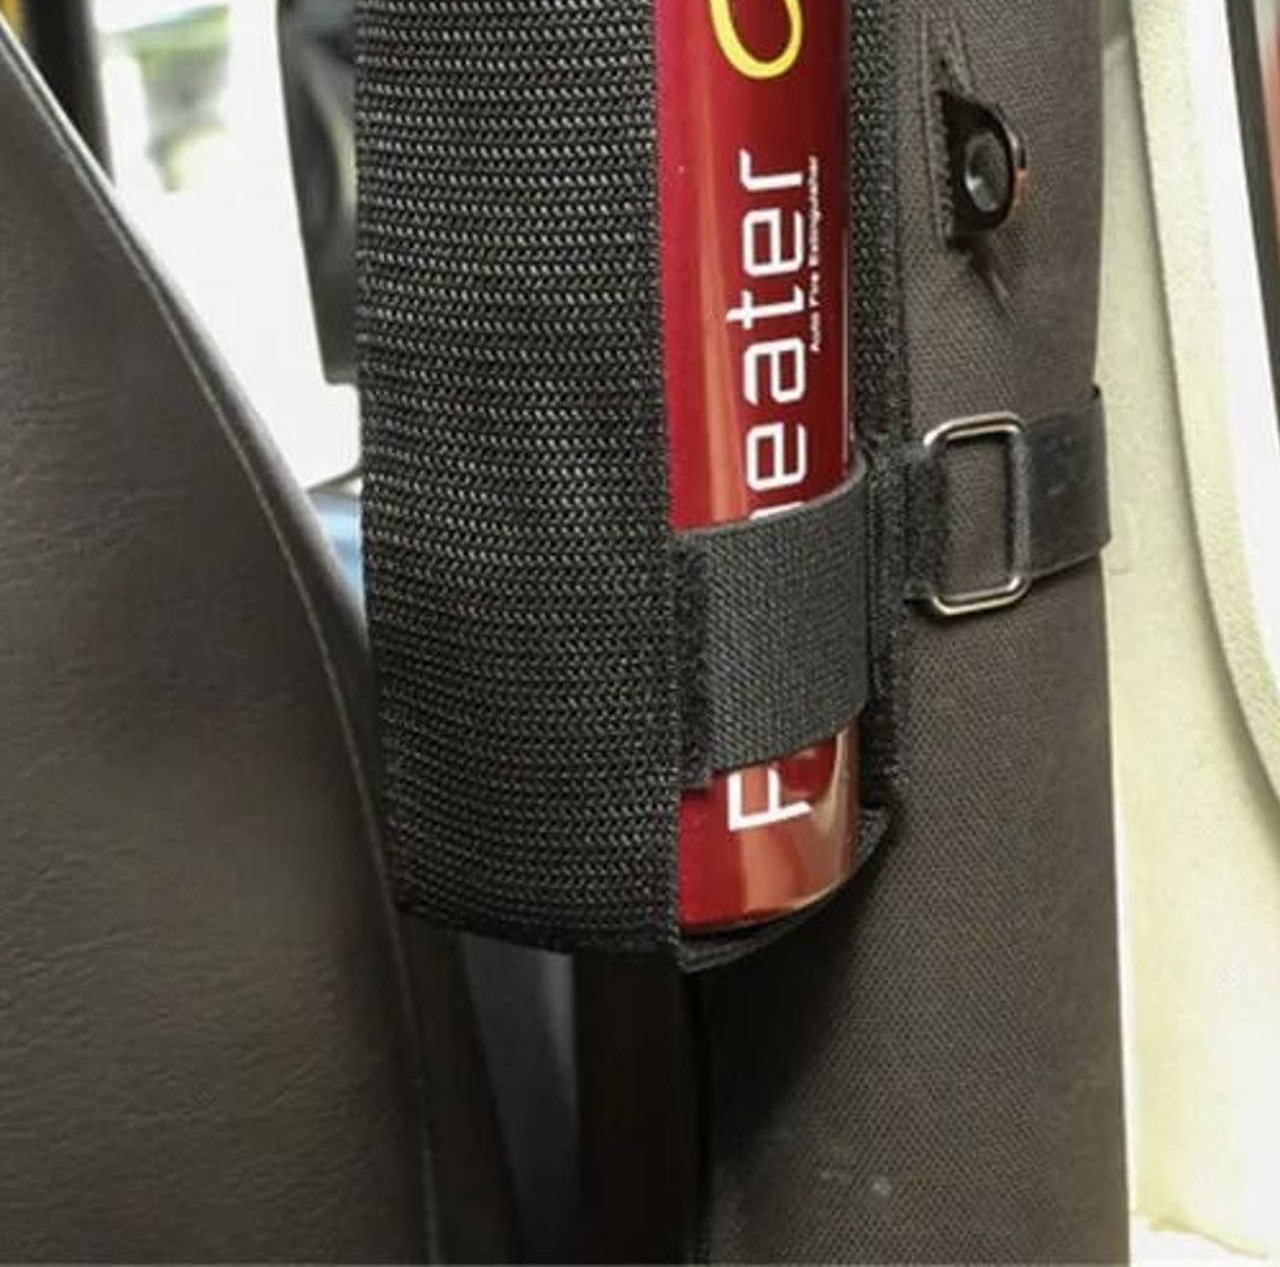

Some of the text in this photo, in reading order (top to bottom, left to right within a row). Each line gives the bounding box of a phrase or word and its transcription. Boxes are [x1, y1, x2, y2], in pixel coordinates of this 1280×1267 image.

[726, 147, 807, 520] eater
[807, 155, 821, 353] Auto Fire Extinguisher
